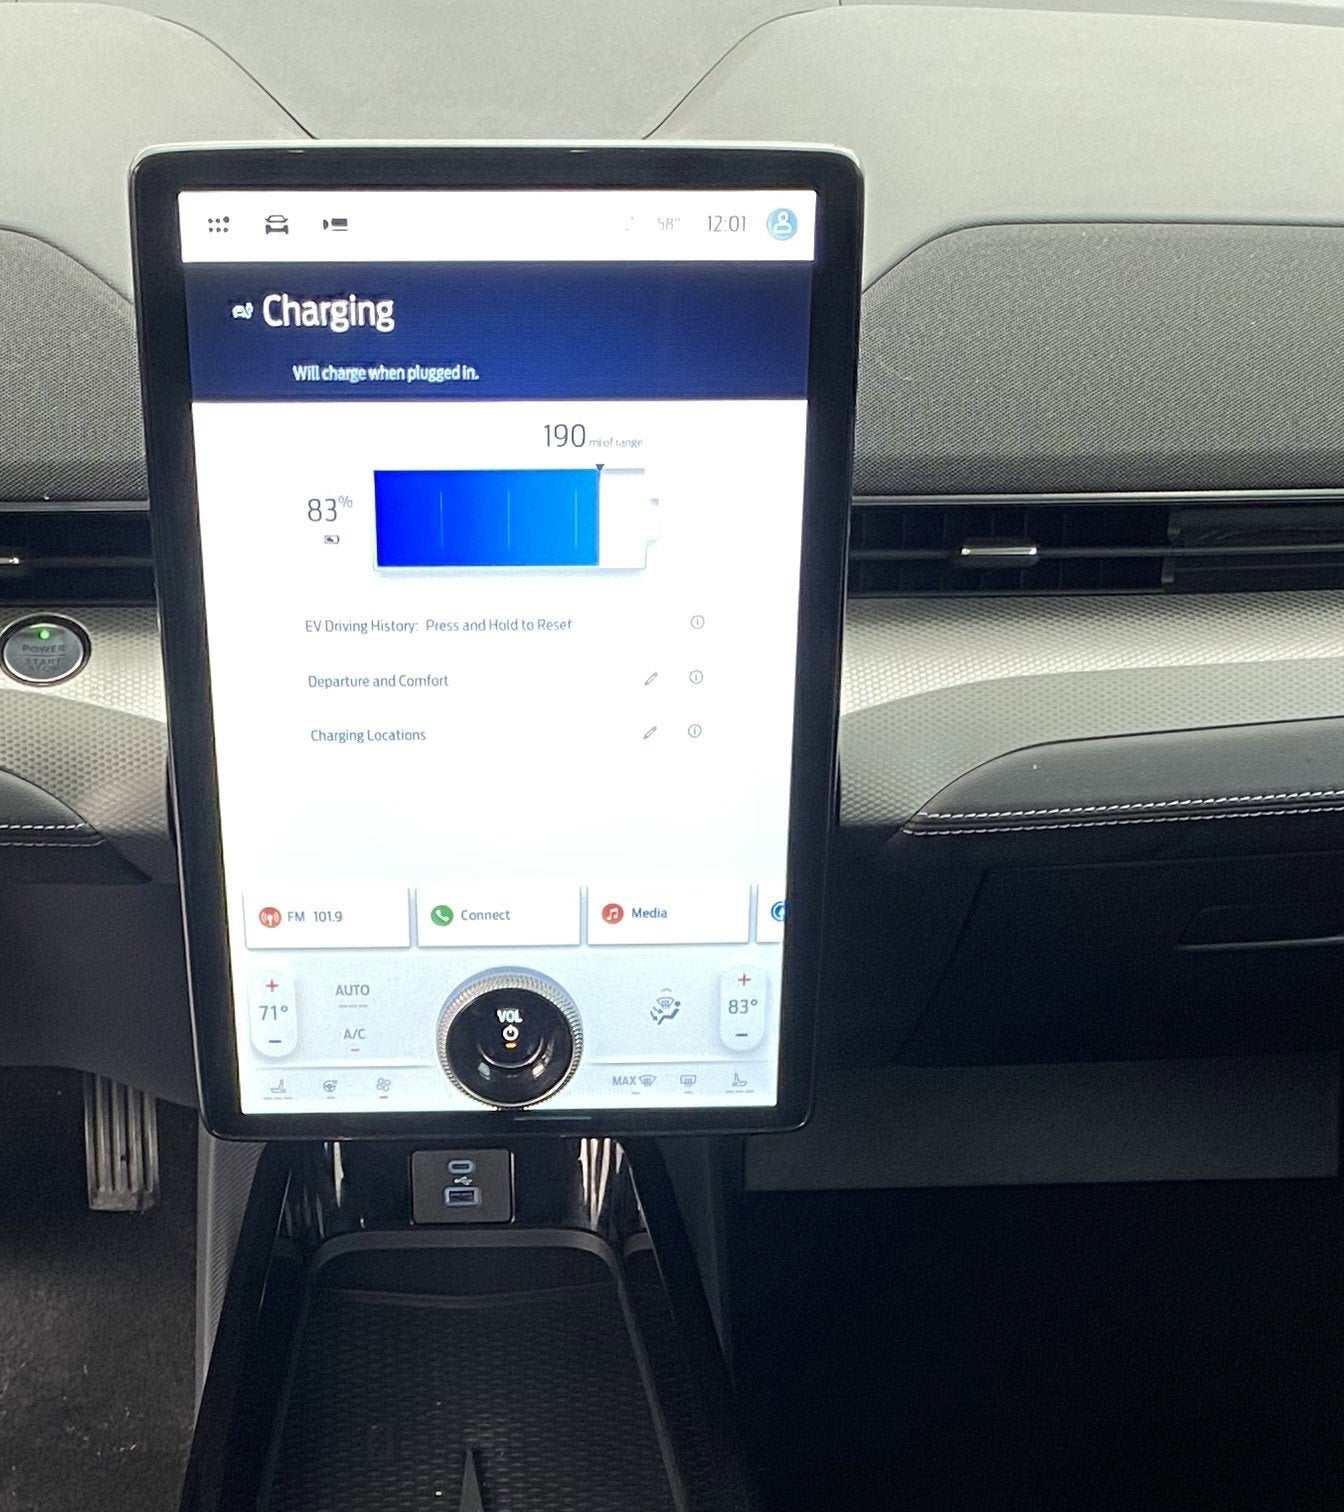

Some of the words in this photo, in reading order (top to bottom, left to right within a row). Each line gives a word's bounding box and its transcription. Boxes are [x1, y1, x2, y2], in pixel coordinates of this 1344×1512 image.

[708, 215, 747, 232] 12:01
[262, 293, 396, 333] Charging
[292, 365, 321, 381] Will
[321, 365, 367, 383] charge
[367, 365, 405, 381] when
[407, 364, 461, 383] plugged
[462, 365, 480, 380] in.
[543, 423, 586, 448] 190
[305, 620, 322, 633] EV
[325, 619, 368, 635] Driving
[371, 619, 419, 635] History:
[425, 619, 459, 632] Press
[462, 619, 486, 631] and
[488, 618, 519, 632] Hold
[521, 619, 535, 631] to
[537, 618, 573, 631] Reset
[22, 644, 66, 653] POWER
[308, 675, 370, 690] Departure
[373, 675, 397, 688] and
[398, 674, 450, 688] Comfort
[311, 730, 364, 743] Charging
[367, 728, 427, 742] Locations
[287, 910, 306, 923] FM
[313, 911, 344, 923] 101.9
[460, 908, 511, 922] Connect
[631, 906, 669, 920] Media
[335, 983, 371, 997] AUTO
[258, 1004, 289, 1021] 71°
[728, 998, 759, 1015] 83°
[496, 1008, 523, 1024] VOL
[343, 1027, 367, 1041] A/C
[612, 1074, 637, 1087] MAX
